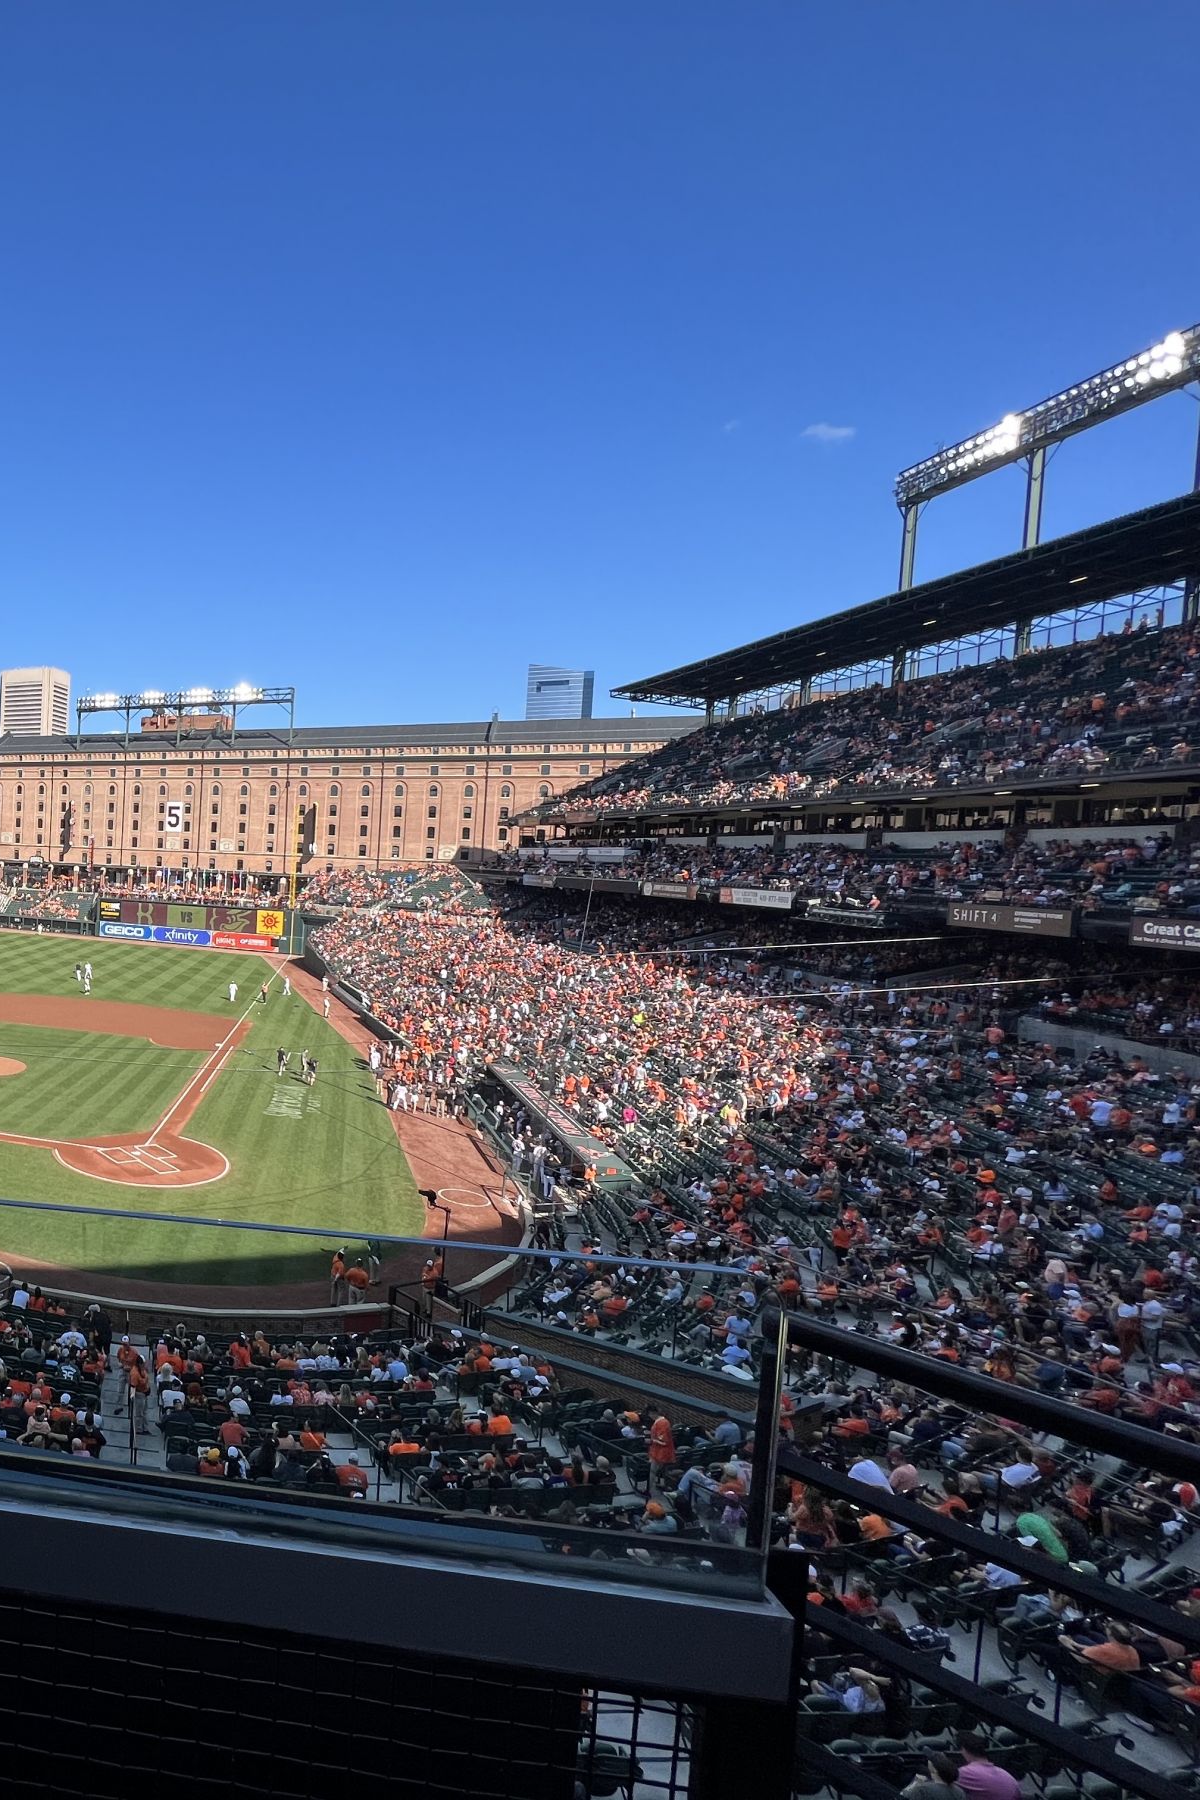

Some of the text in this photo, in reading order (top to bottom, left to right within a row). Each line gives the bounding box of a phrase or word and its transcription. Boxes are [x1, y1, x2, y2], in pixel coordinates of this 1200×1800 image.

[167, 806, 180, 828] 5
[180, 912, 193, 924] VS
[104, 924, 145, 937] GEICO
[165, 929, 198, 943] xfinity
[1143, 922, 1181, 937] Great
